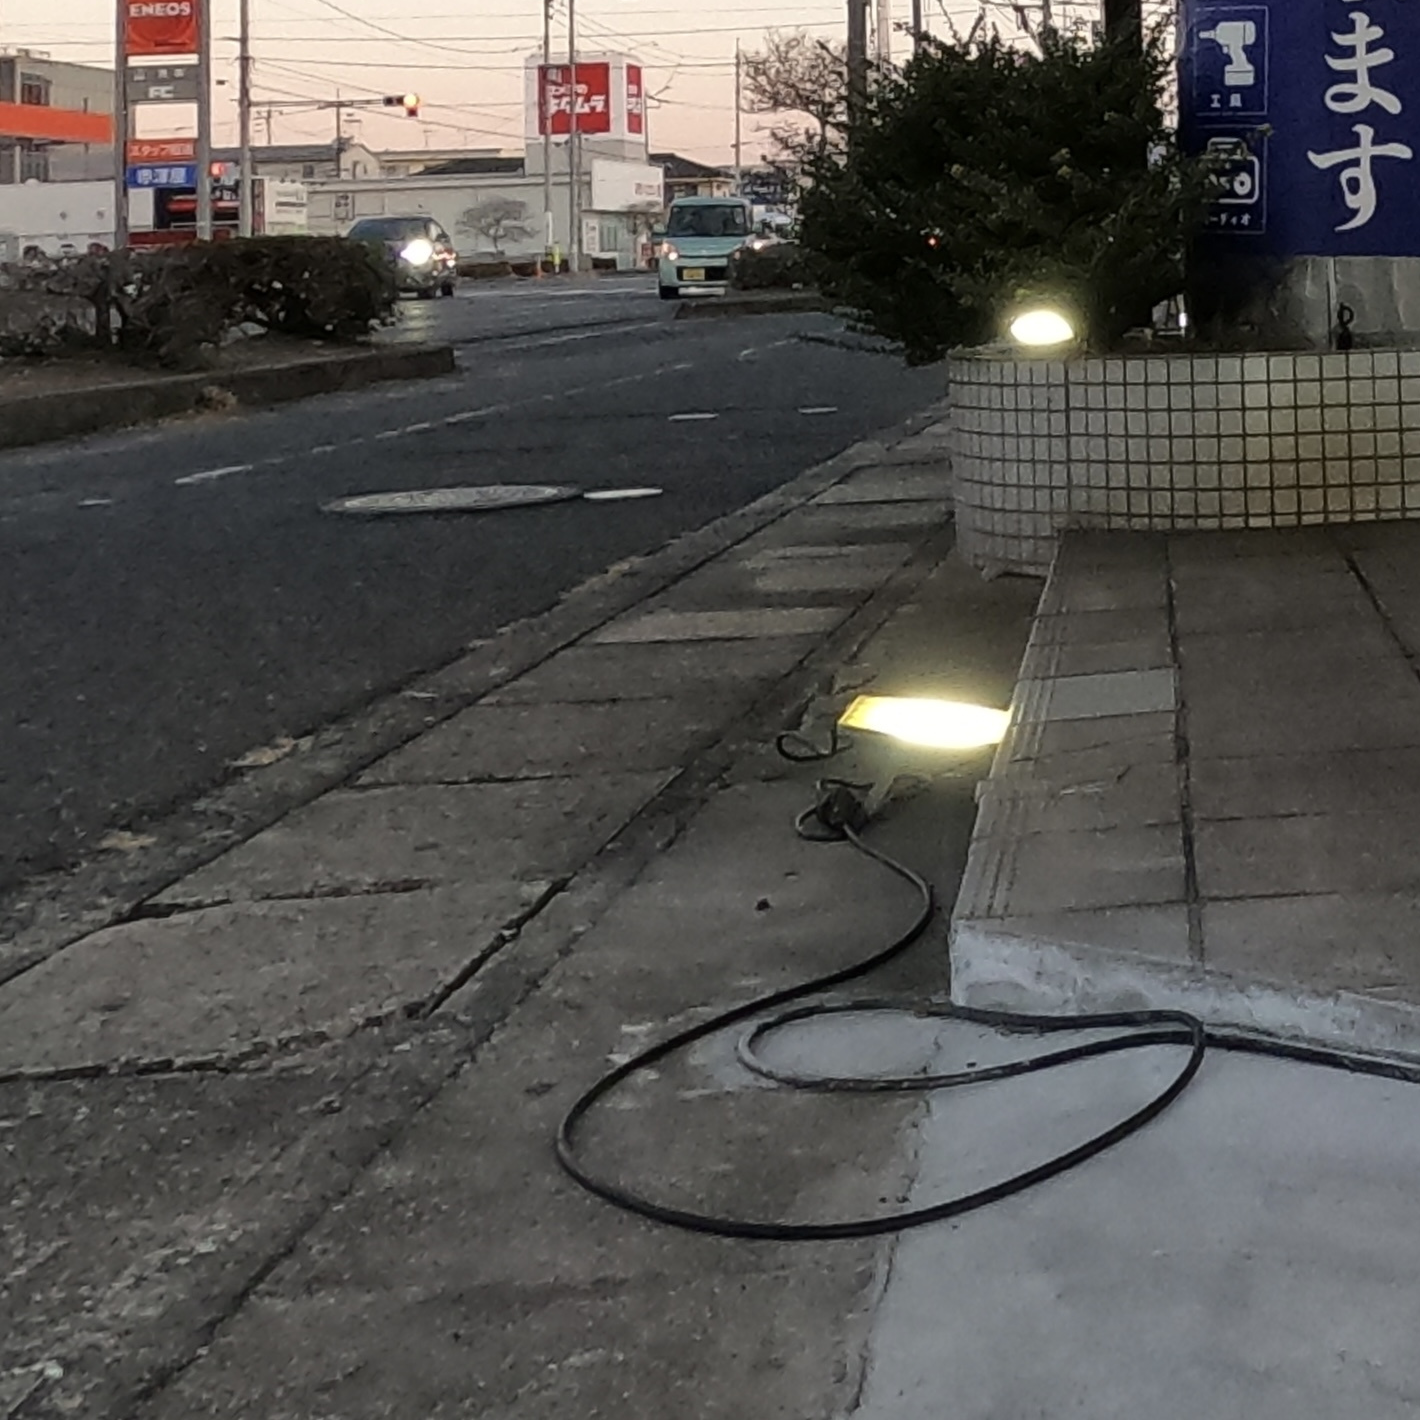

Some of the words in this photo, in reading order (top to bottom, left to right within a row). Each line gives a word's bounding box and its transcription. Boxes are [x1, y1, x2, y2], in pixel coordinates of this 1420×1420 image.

[128, 1, 192, 18] ENEOS
[1203, 212, 1252, 227] ーディオ
